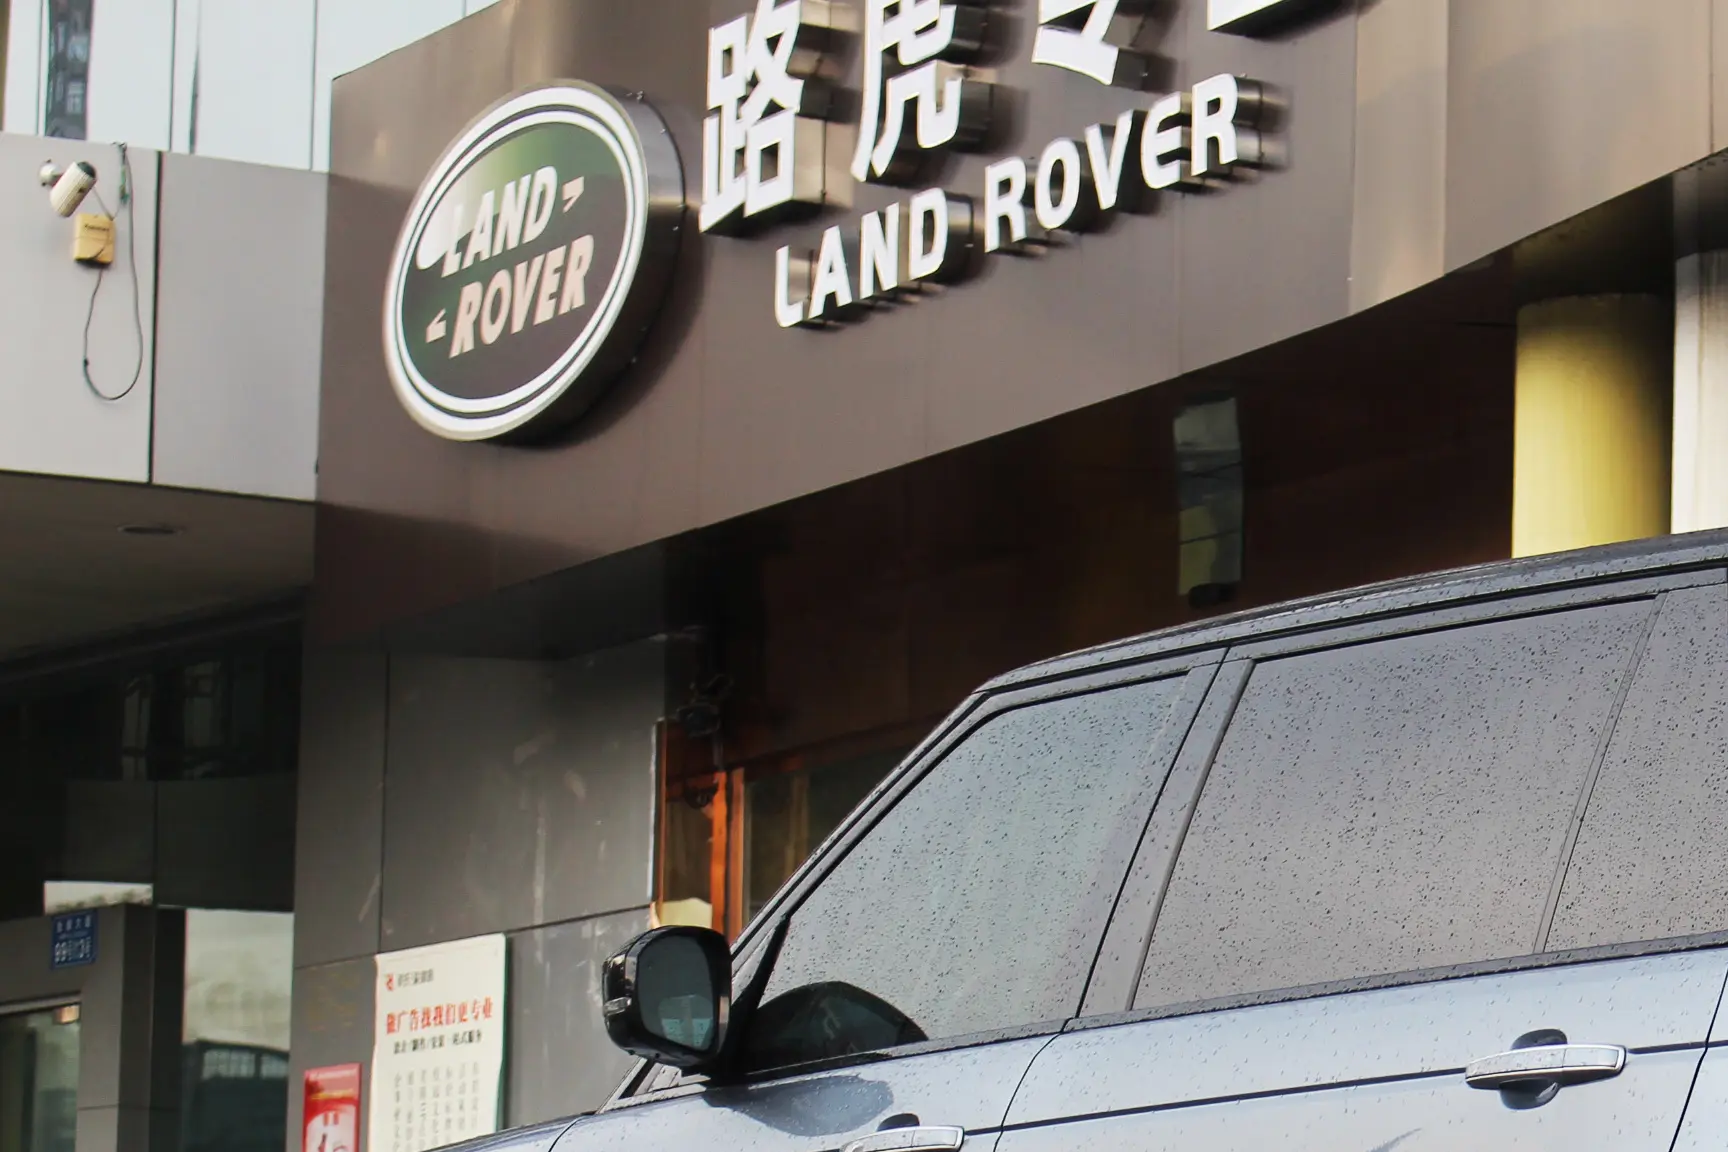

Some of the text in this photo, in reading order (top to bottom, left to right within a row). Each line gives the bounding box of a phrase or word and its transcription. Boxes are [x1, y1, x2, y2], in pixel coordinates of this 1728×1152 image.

[441, 165, 558, 278] LAND
[774, 73, 1238, 329] LAND ROVER
[449, 234, 594, 359] ROVER
